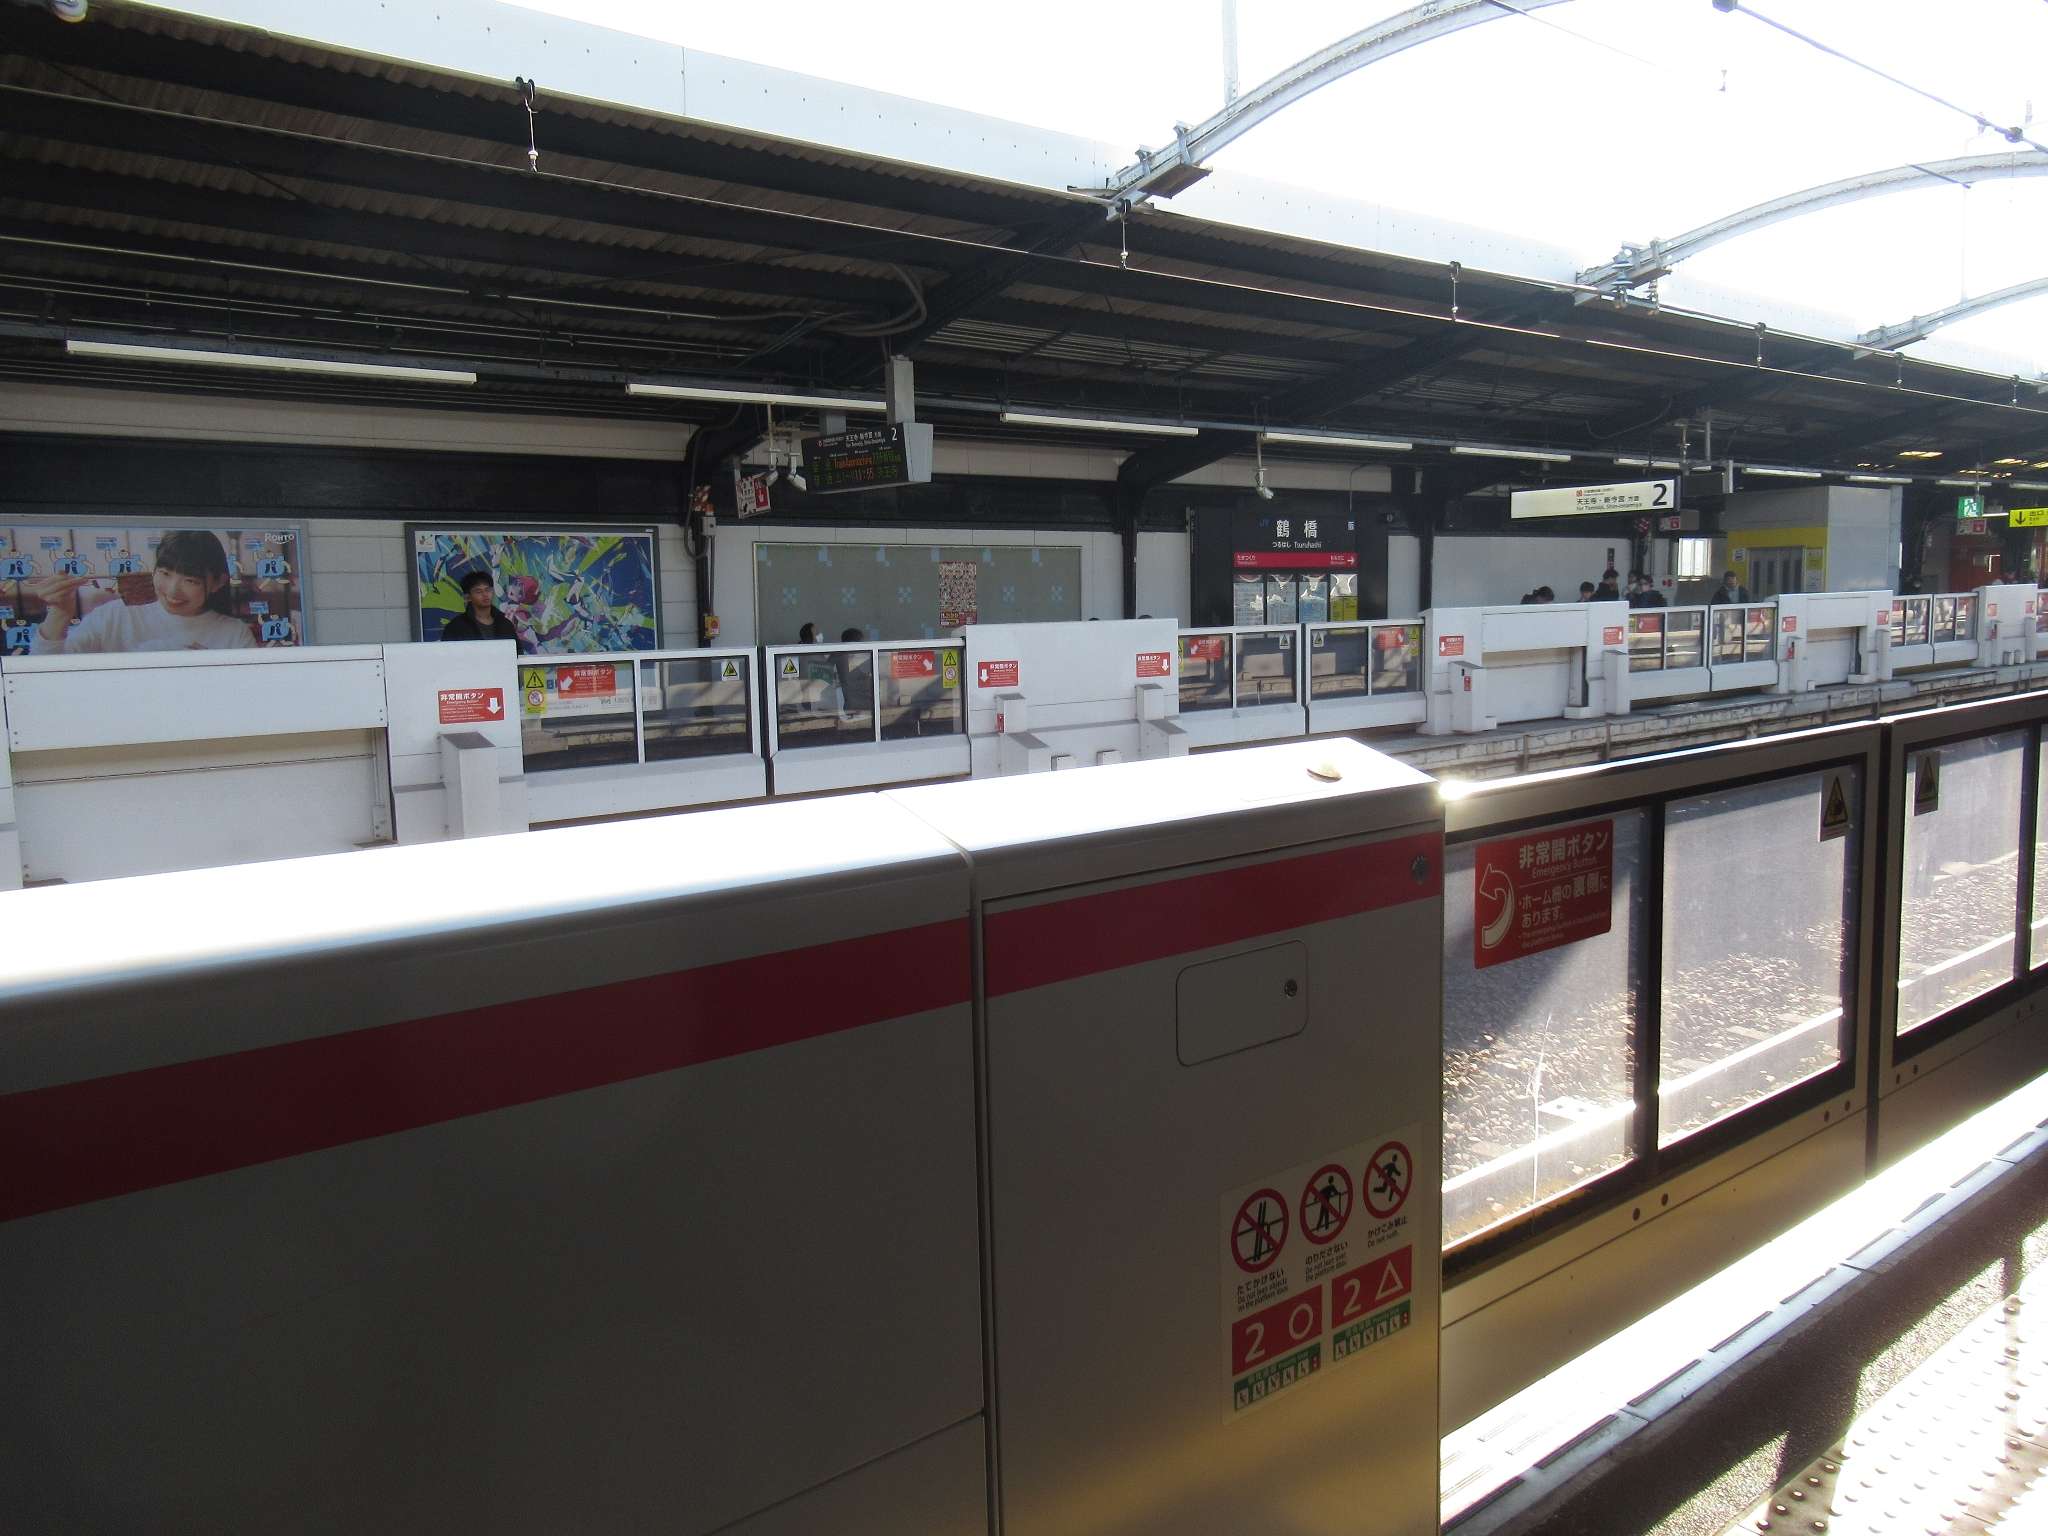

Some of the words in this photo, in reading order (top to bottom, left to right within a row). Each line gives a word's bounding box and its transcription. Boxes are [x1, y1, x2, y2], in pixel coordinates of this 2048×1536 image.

[891, 428, 898, 441] 2
[1652, 483, 1667, 506] 2
[1276, 519, 1318, 538] 鶴橋
[1519, 831, 1608, 870] 非常開ボタン
[1532, 862, 1571, 879] Emergency
[1572, 856, 1597, 868] Button
[1305, 1240, 1348, 1265] のりださない
[1237, 1269, 1284, 1294] たてかけない
[1343, 1278, 1361, 1316] 2
[1244, 1322, 1266, 1363] 2
